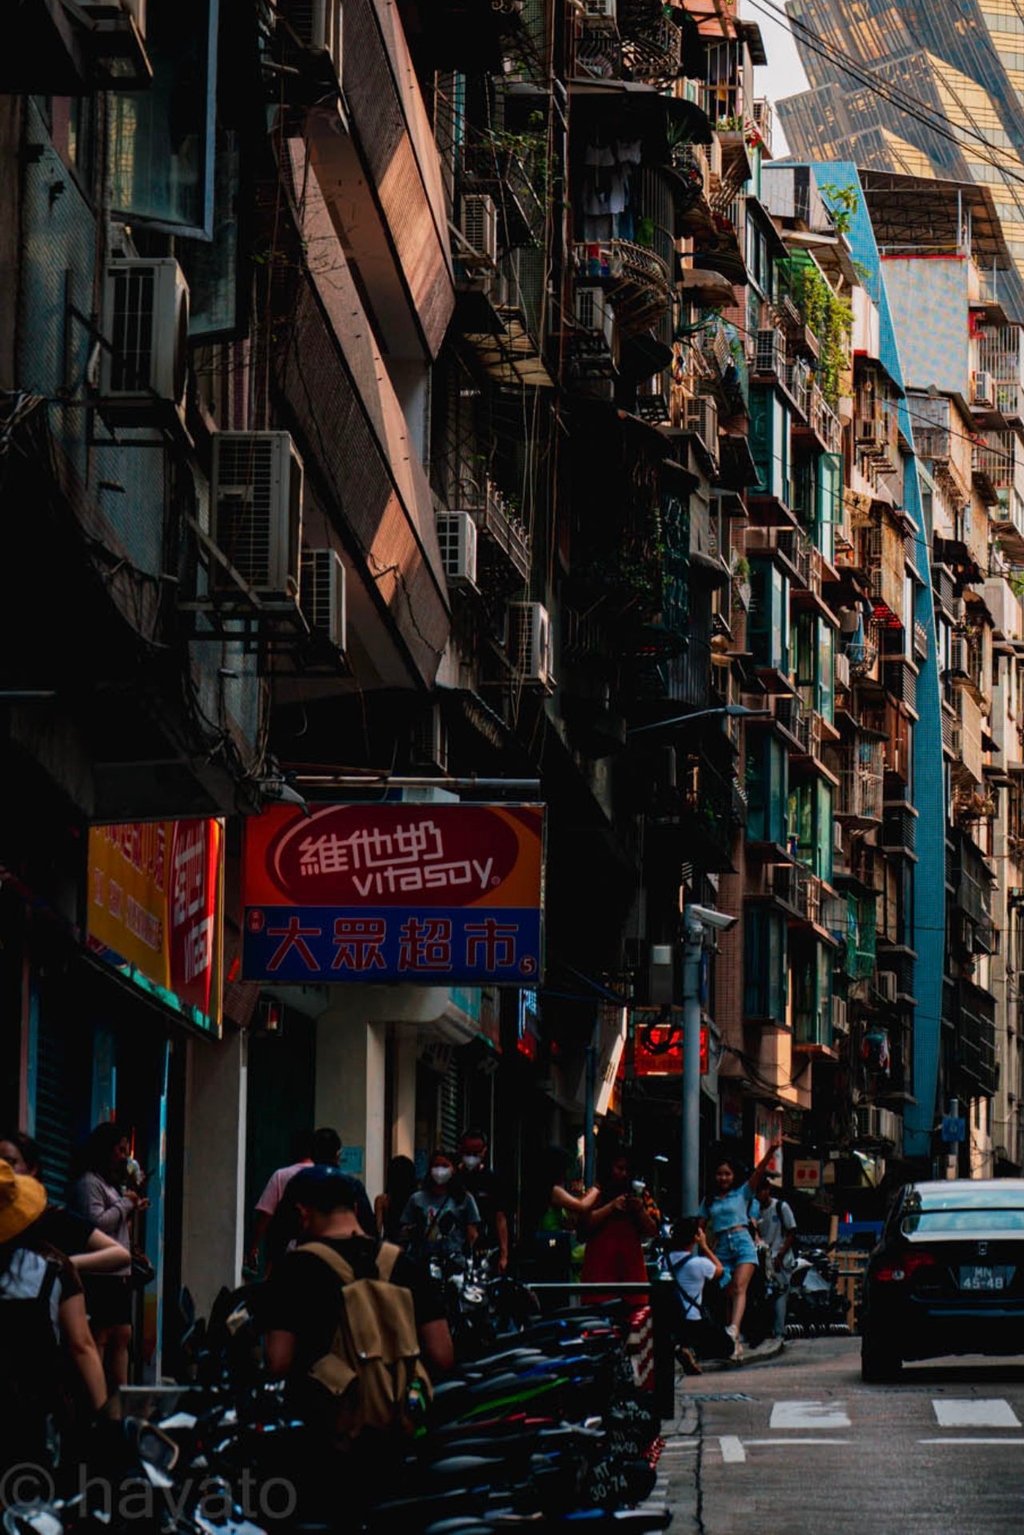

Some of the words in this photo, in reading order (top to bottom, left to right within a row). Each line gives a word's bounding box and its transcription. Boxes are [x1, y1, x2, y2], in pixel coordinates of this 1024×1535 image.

[299, 820, 444, 877] 維他奶
[351, 857, 493, 897] vitasoy
[266, 916, 519, 972] 大眾超市
